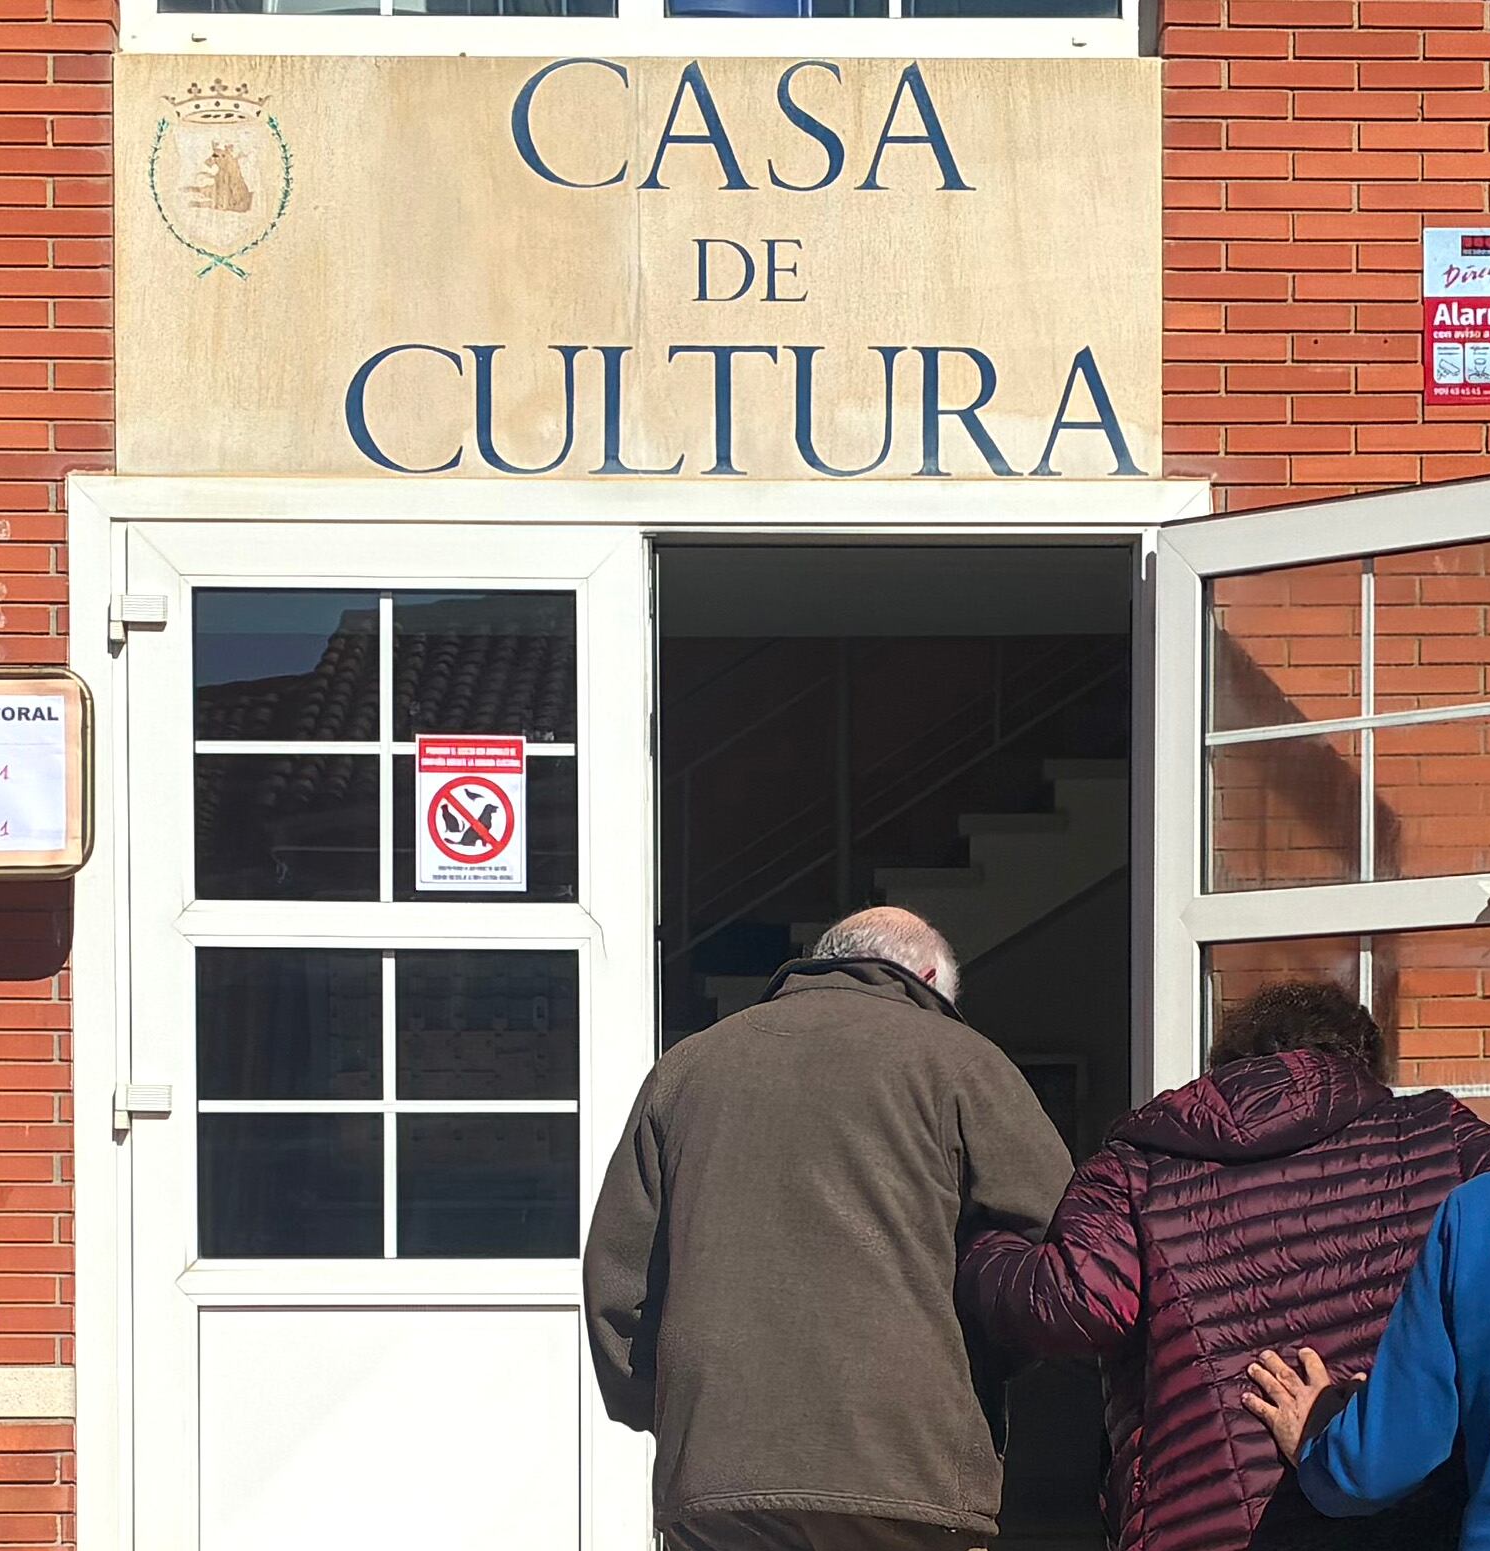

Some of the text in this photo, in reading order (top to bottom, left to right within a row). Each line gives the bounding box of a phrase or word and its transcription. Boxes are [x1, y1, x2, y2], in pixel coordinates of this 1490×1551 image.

[511, 58, 977, 192] CASA
[692, 238, 808, 302] DE
[345, 343, 1148, 477] CULTURA
